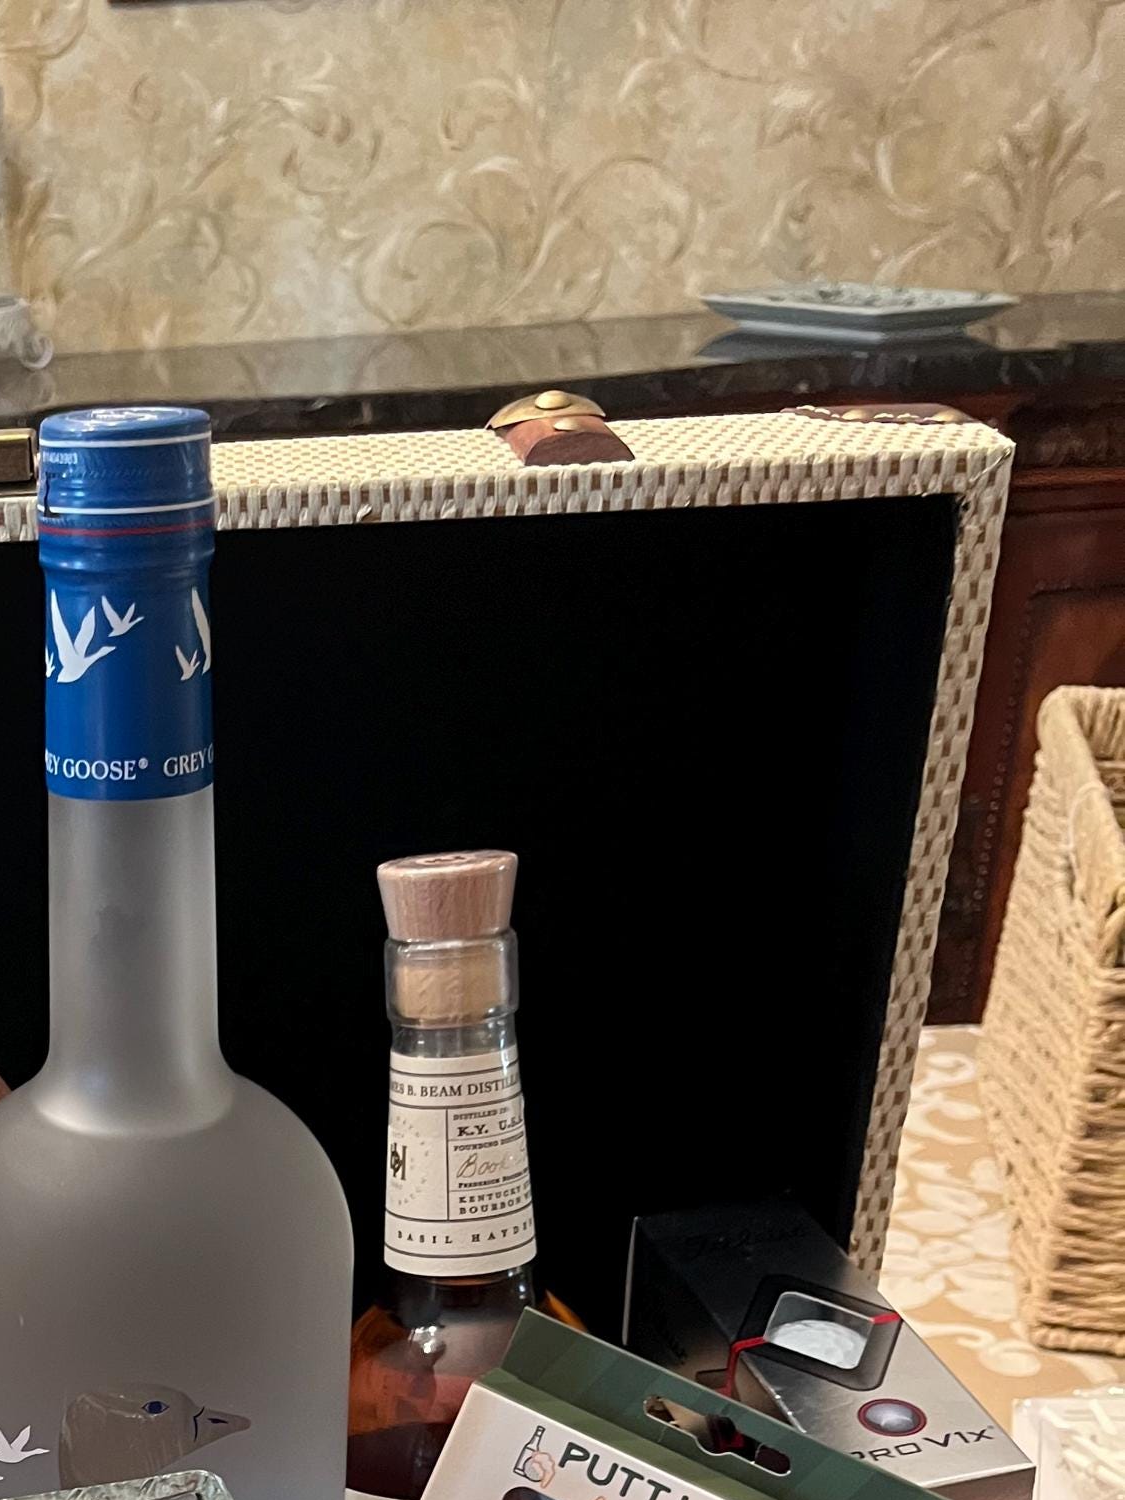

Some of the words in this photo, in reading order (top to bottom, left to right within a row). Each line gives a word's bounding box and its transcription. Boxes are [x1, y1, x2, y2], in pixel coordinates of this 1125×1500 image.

[163, 748, 208, 777] GREY
[420, 1084, 463, 1098] BEAM
[459, 1185, 521, 1204] KENTUCKY
[459, 1195, 522, 1215] BOURBON
[397, 1230, 453, 1244] BASIL
